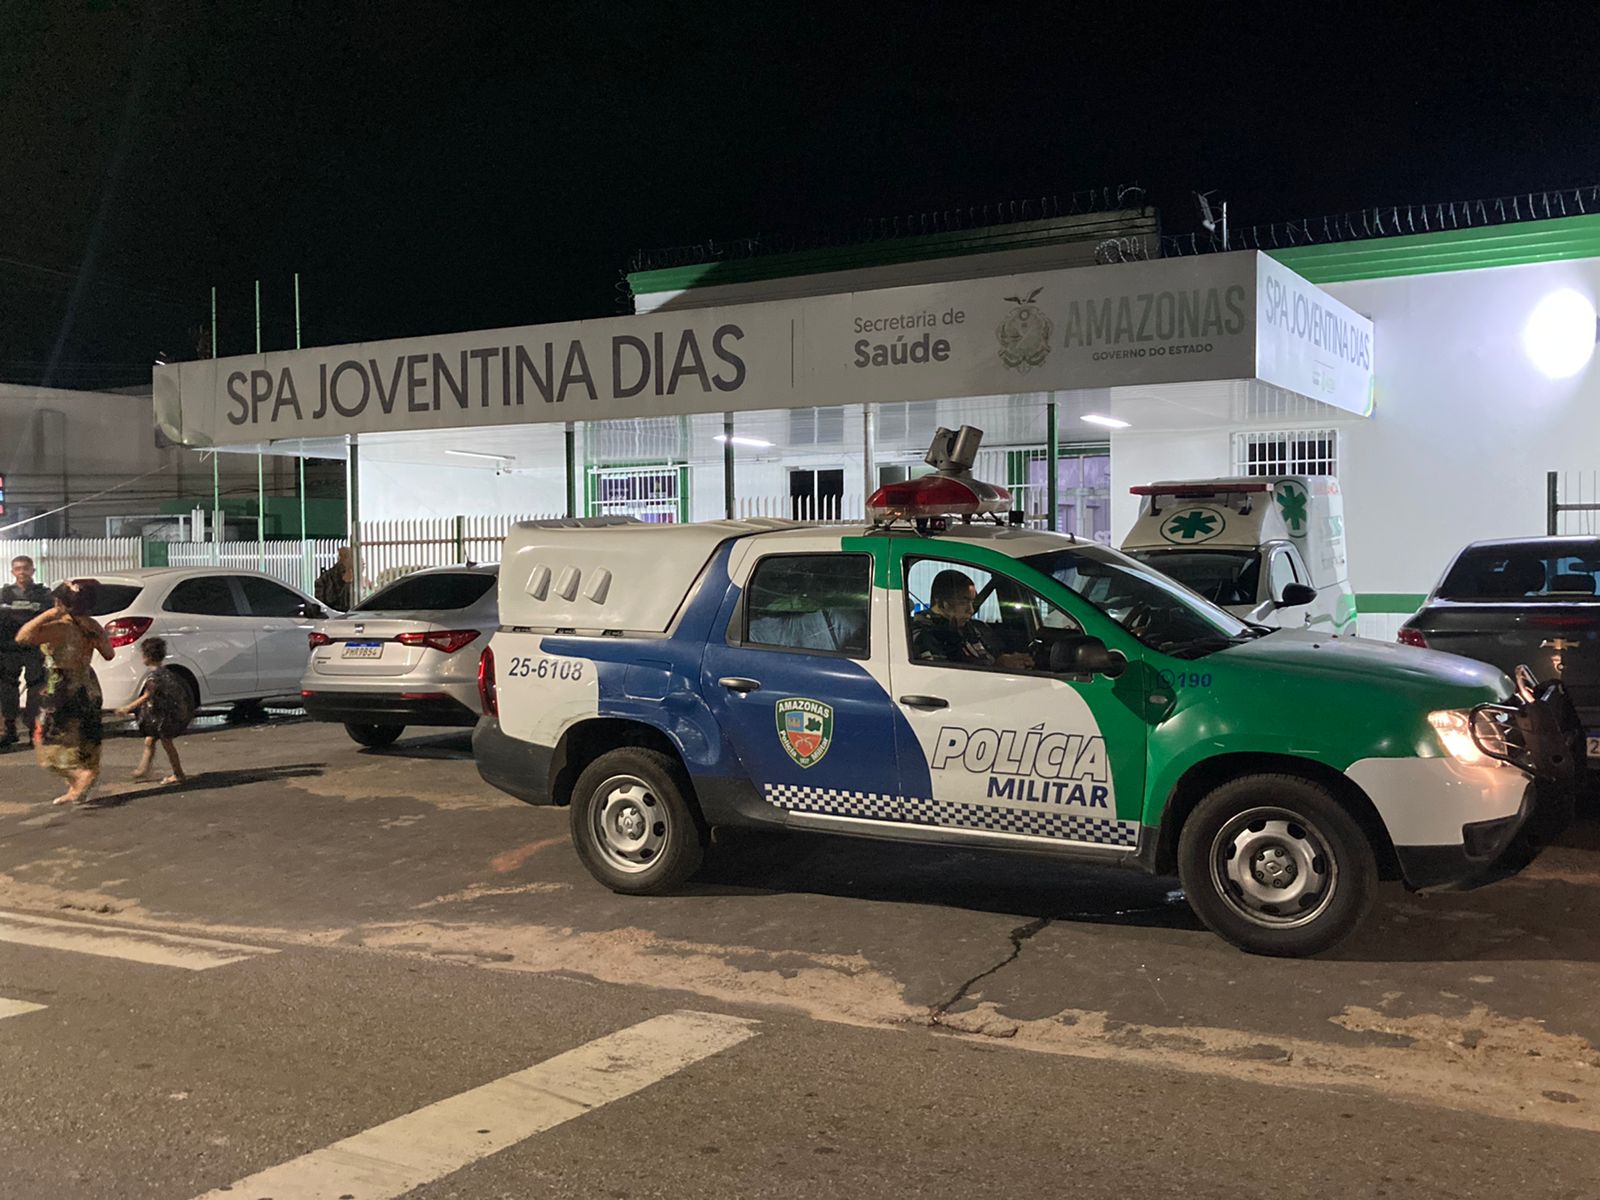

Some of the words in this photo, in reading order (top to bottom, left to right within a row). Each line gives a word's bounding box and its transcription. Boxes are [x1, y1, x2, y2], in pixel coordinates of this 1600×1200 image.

[853, 310, 937, 333] Secretaria
[942, 308, 965, 325] de
[1063, 285, 1246, 348] AMAZONAS
[1265, 275, 1289, 331] SPA
[1290, 291, 1349, 361] JOVENTINA
[1350, 325, 1370, 371] DIAS
[854, 333, 951, 368] Saúde
[1092, 347, 1146, 361] GOVERNO
[1149, 347, 1166, 357] DO
[1169, 343, 1213, 355] ESTADO
[226, 367, 303, 425] SPA
[312, 340, 598, 420] JOVENTINA
[612, 324, 746, 399] DIAS
[508, 656, 583, 681] 25-6108
[1177, 672, 1212, 688] 190
[779, 700, 830, 719] AMAZONAS
[811, 737, 829, 761] Militar
[931, 722, 1107, 783] POLÍCIA
[987, 776, 1108, 808] MILITAR
